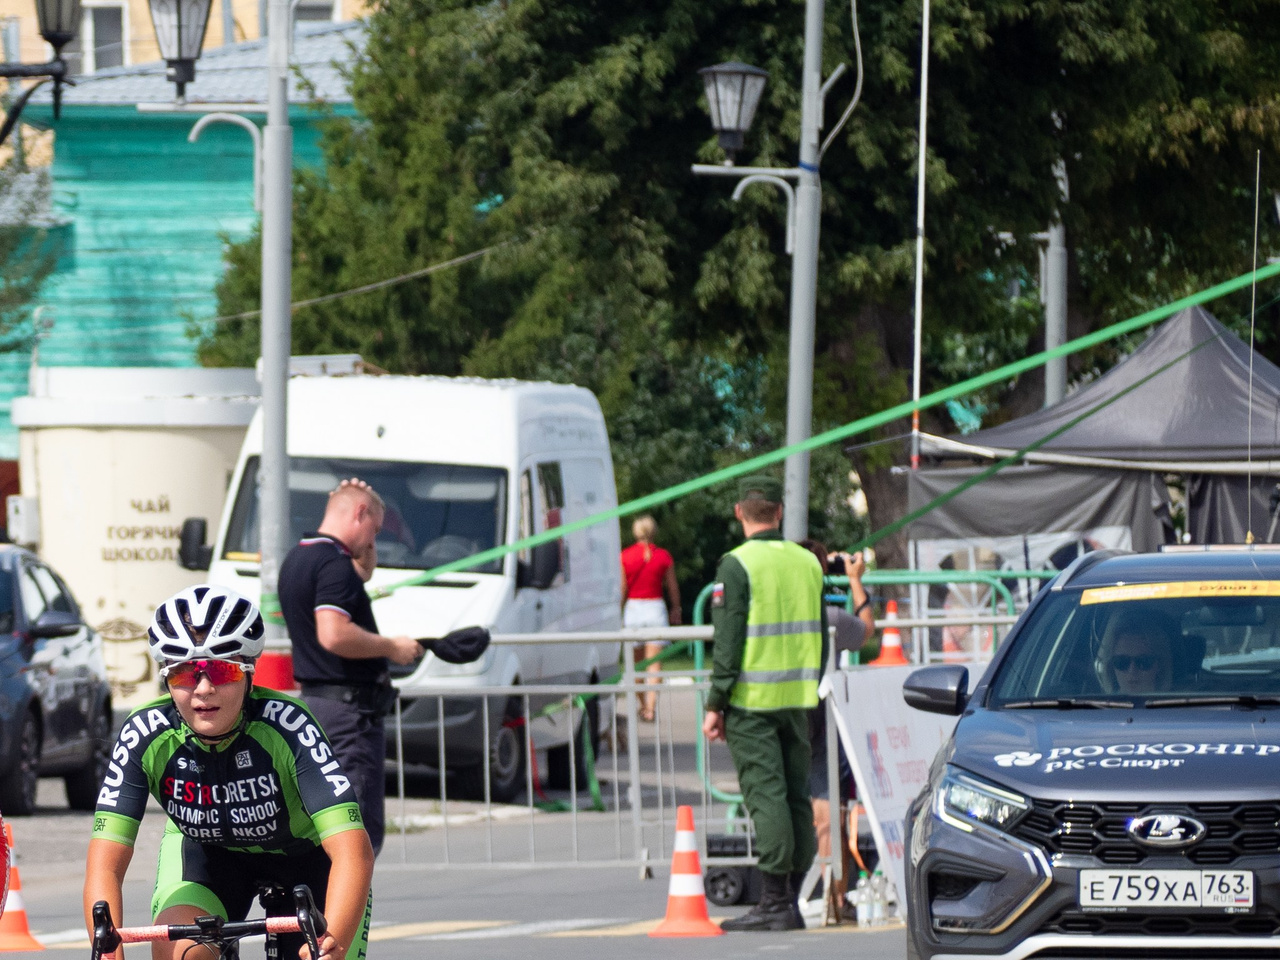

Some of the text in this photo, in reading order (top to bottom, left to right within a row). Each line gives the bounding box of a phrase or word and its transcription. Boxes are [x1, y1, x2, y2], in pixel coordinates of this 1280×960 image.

[130, 495, 170, 513] ЧАЙ
[96, 708, 170, 807] RUSSIA
[262, 700, 352, 797] RUSSIA
[167, 800, 280, 824] OLYMPIC SCHOOL
[1204, 874, 1245, 894] 763
[1213, 895, 1234, 903] RUS
